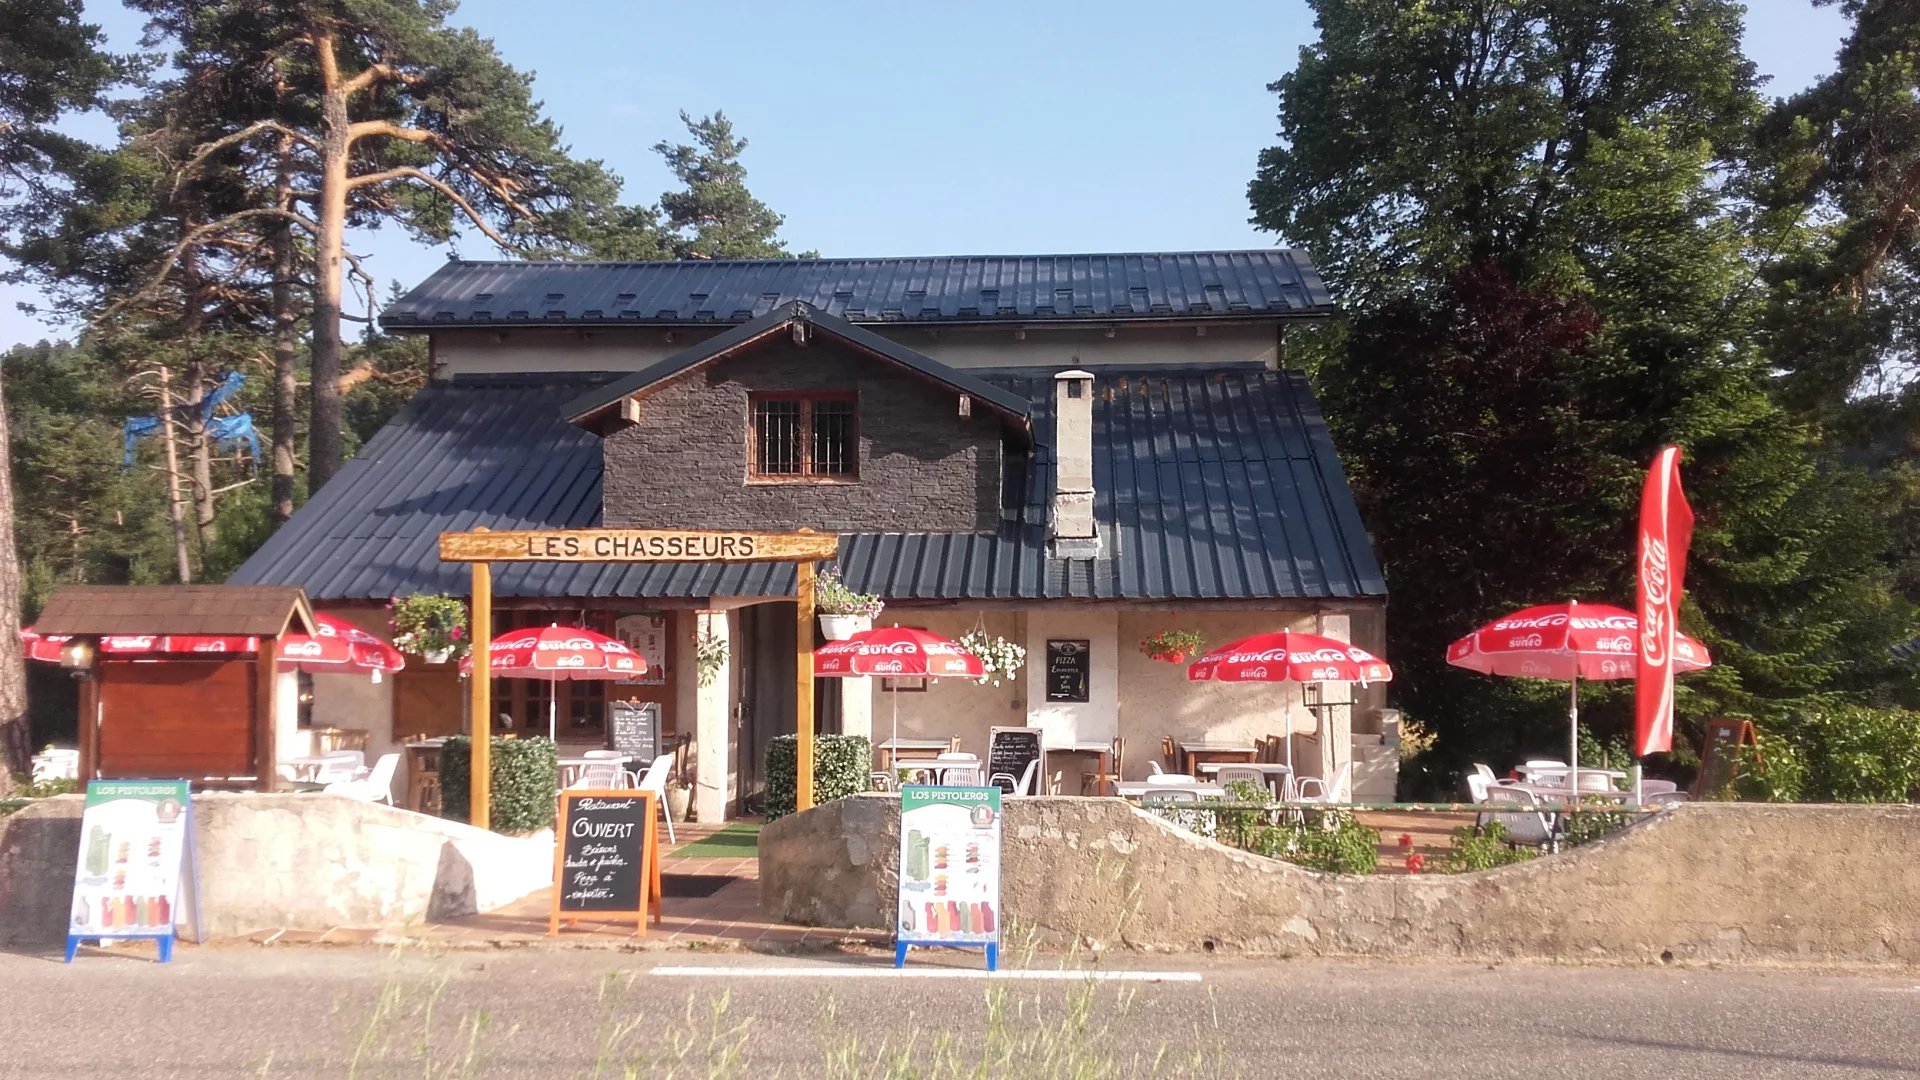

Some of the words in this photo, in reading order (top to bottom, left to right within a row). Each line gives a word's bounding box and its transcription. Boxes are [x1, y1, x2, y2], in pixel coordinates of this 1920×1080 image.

[528, 537, 579, 557] LES
[594, 536, 755, 557] CHASSEURS
[96, 786, 116, 796] LOS
[118, 786, 177, 796] PISTOLEROS
[911, 790, 929, 800] LOS
[932, 791, 989, 801] PISTOLEROS
